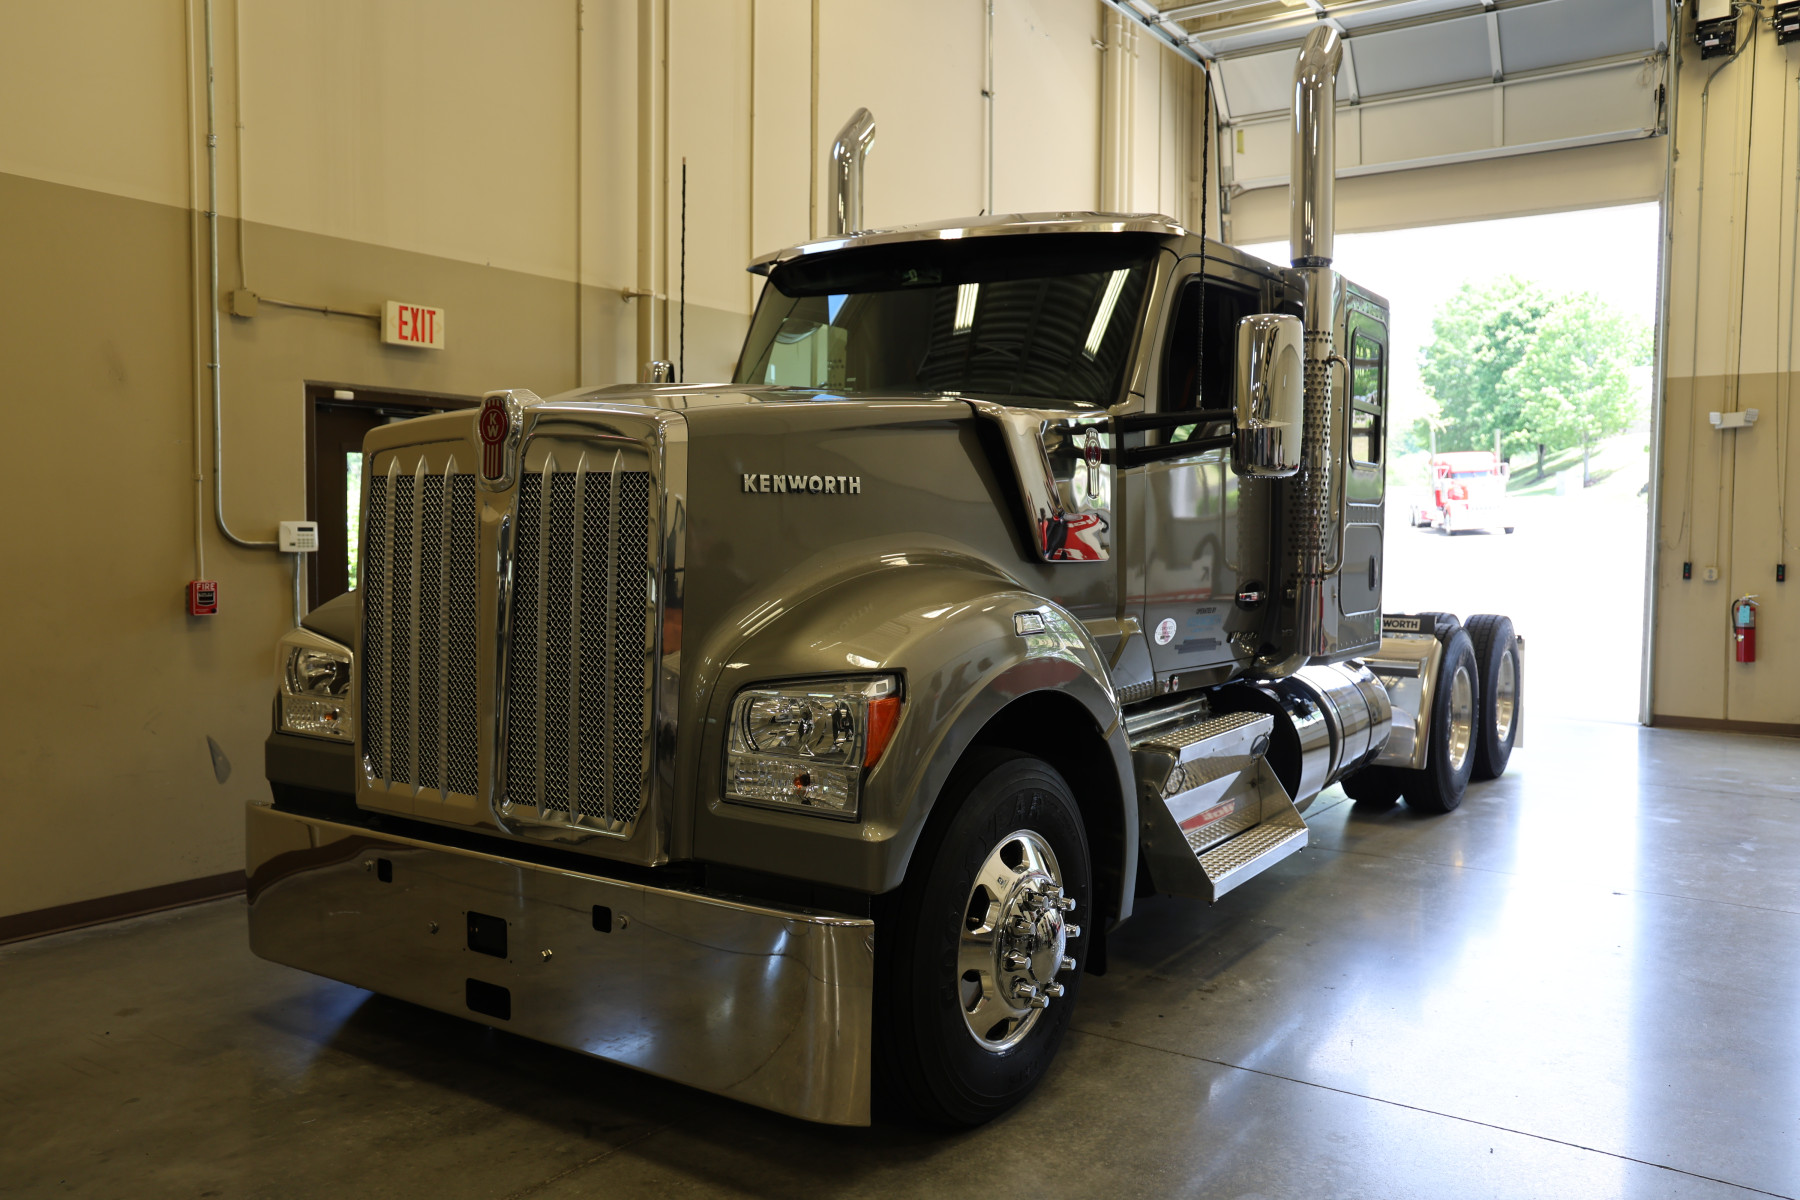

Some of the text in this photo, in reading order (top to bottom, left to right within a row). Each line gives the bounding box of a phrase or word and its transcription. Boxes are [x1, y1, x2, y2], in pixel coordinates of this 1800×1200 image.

[398, 305, 436, 344] EXIT
[489, 412, 497, 425] K
[487, 425, 499, 438] W
[743, 473, 861, 494] KENWORTH
[197, 582, 215, 591] FIRE
[1383, 619, 1418, 629] WORTH
